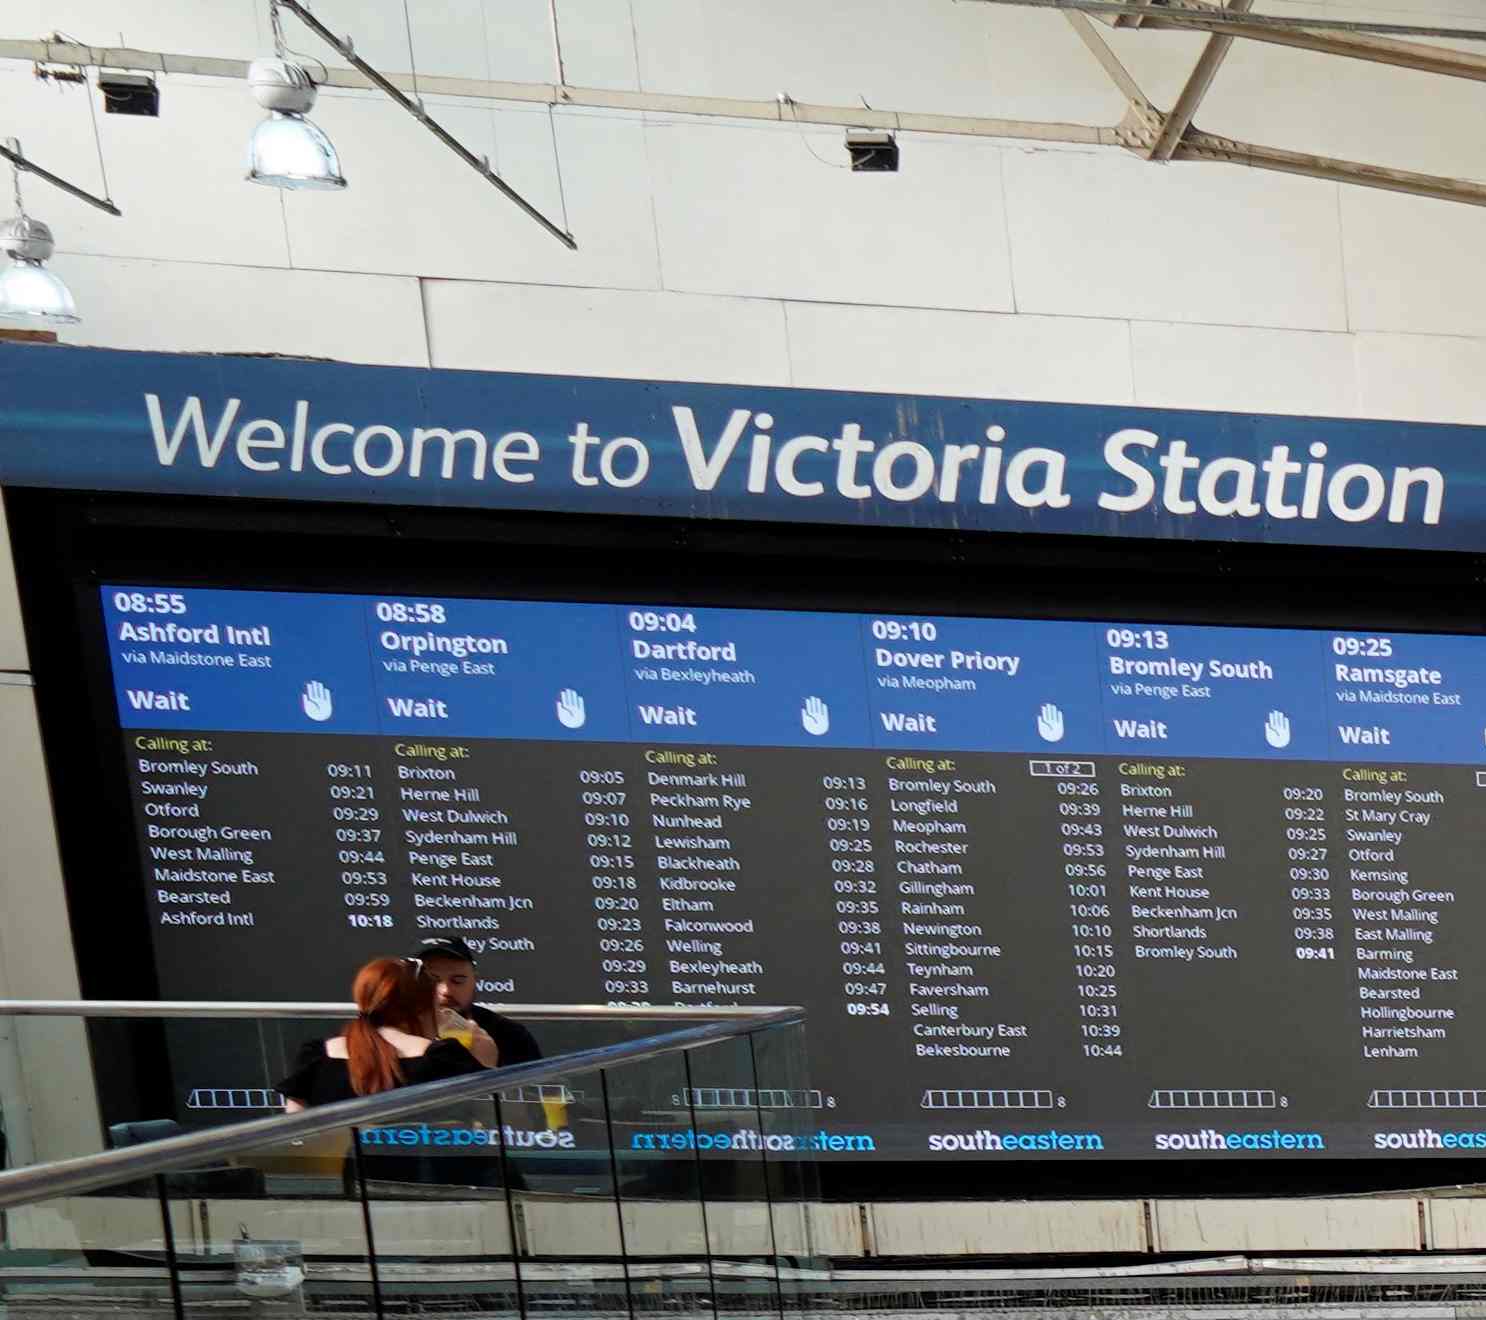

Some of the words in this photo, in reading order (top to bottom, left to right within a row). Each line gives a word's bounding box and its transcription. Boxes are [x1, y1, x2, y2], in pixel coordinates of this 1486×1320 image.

[145, 394, 539, 483] Welcome
[568, 423, 649, 487] to
[672, 406, 1070, 508] Victoria
[1098, 429, 1443, 524] Station
[114, 592, 186, 614] 08:55
[376, 602, 446, 624] 08:58
[120, 622, 219, 644] Ashford
[226, 626, 270, 646] Intl
[872, 620, 936, 641] 09:10
[381, 631, 508, 657] Orpington
[121, 652, 147, 665] via
[150, 650, 234, 666] Maidstone
[238, 653, 272, 668] East
[875, 648, 945, 668] Dover
[951, 651, 1020, 676] Priory
[127, 690, 190, 711] Wait
[141, 781, 208, 799] Swanley
[330, 785, 374, 799] 09:21
[905, 942, 1001, 959] Sittingbourne
[1074, 945, 1113, 957] 10:15
[929, 1130, 1104, 1151] southeastern
